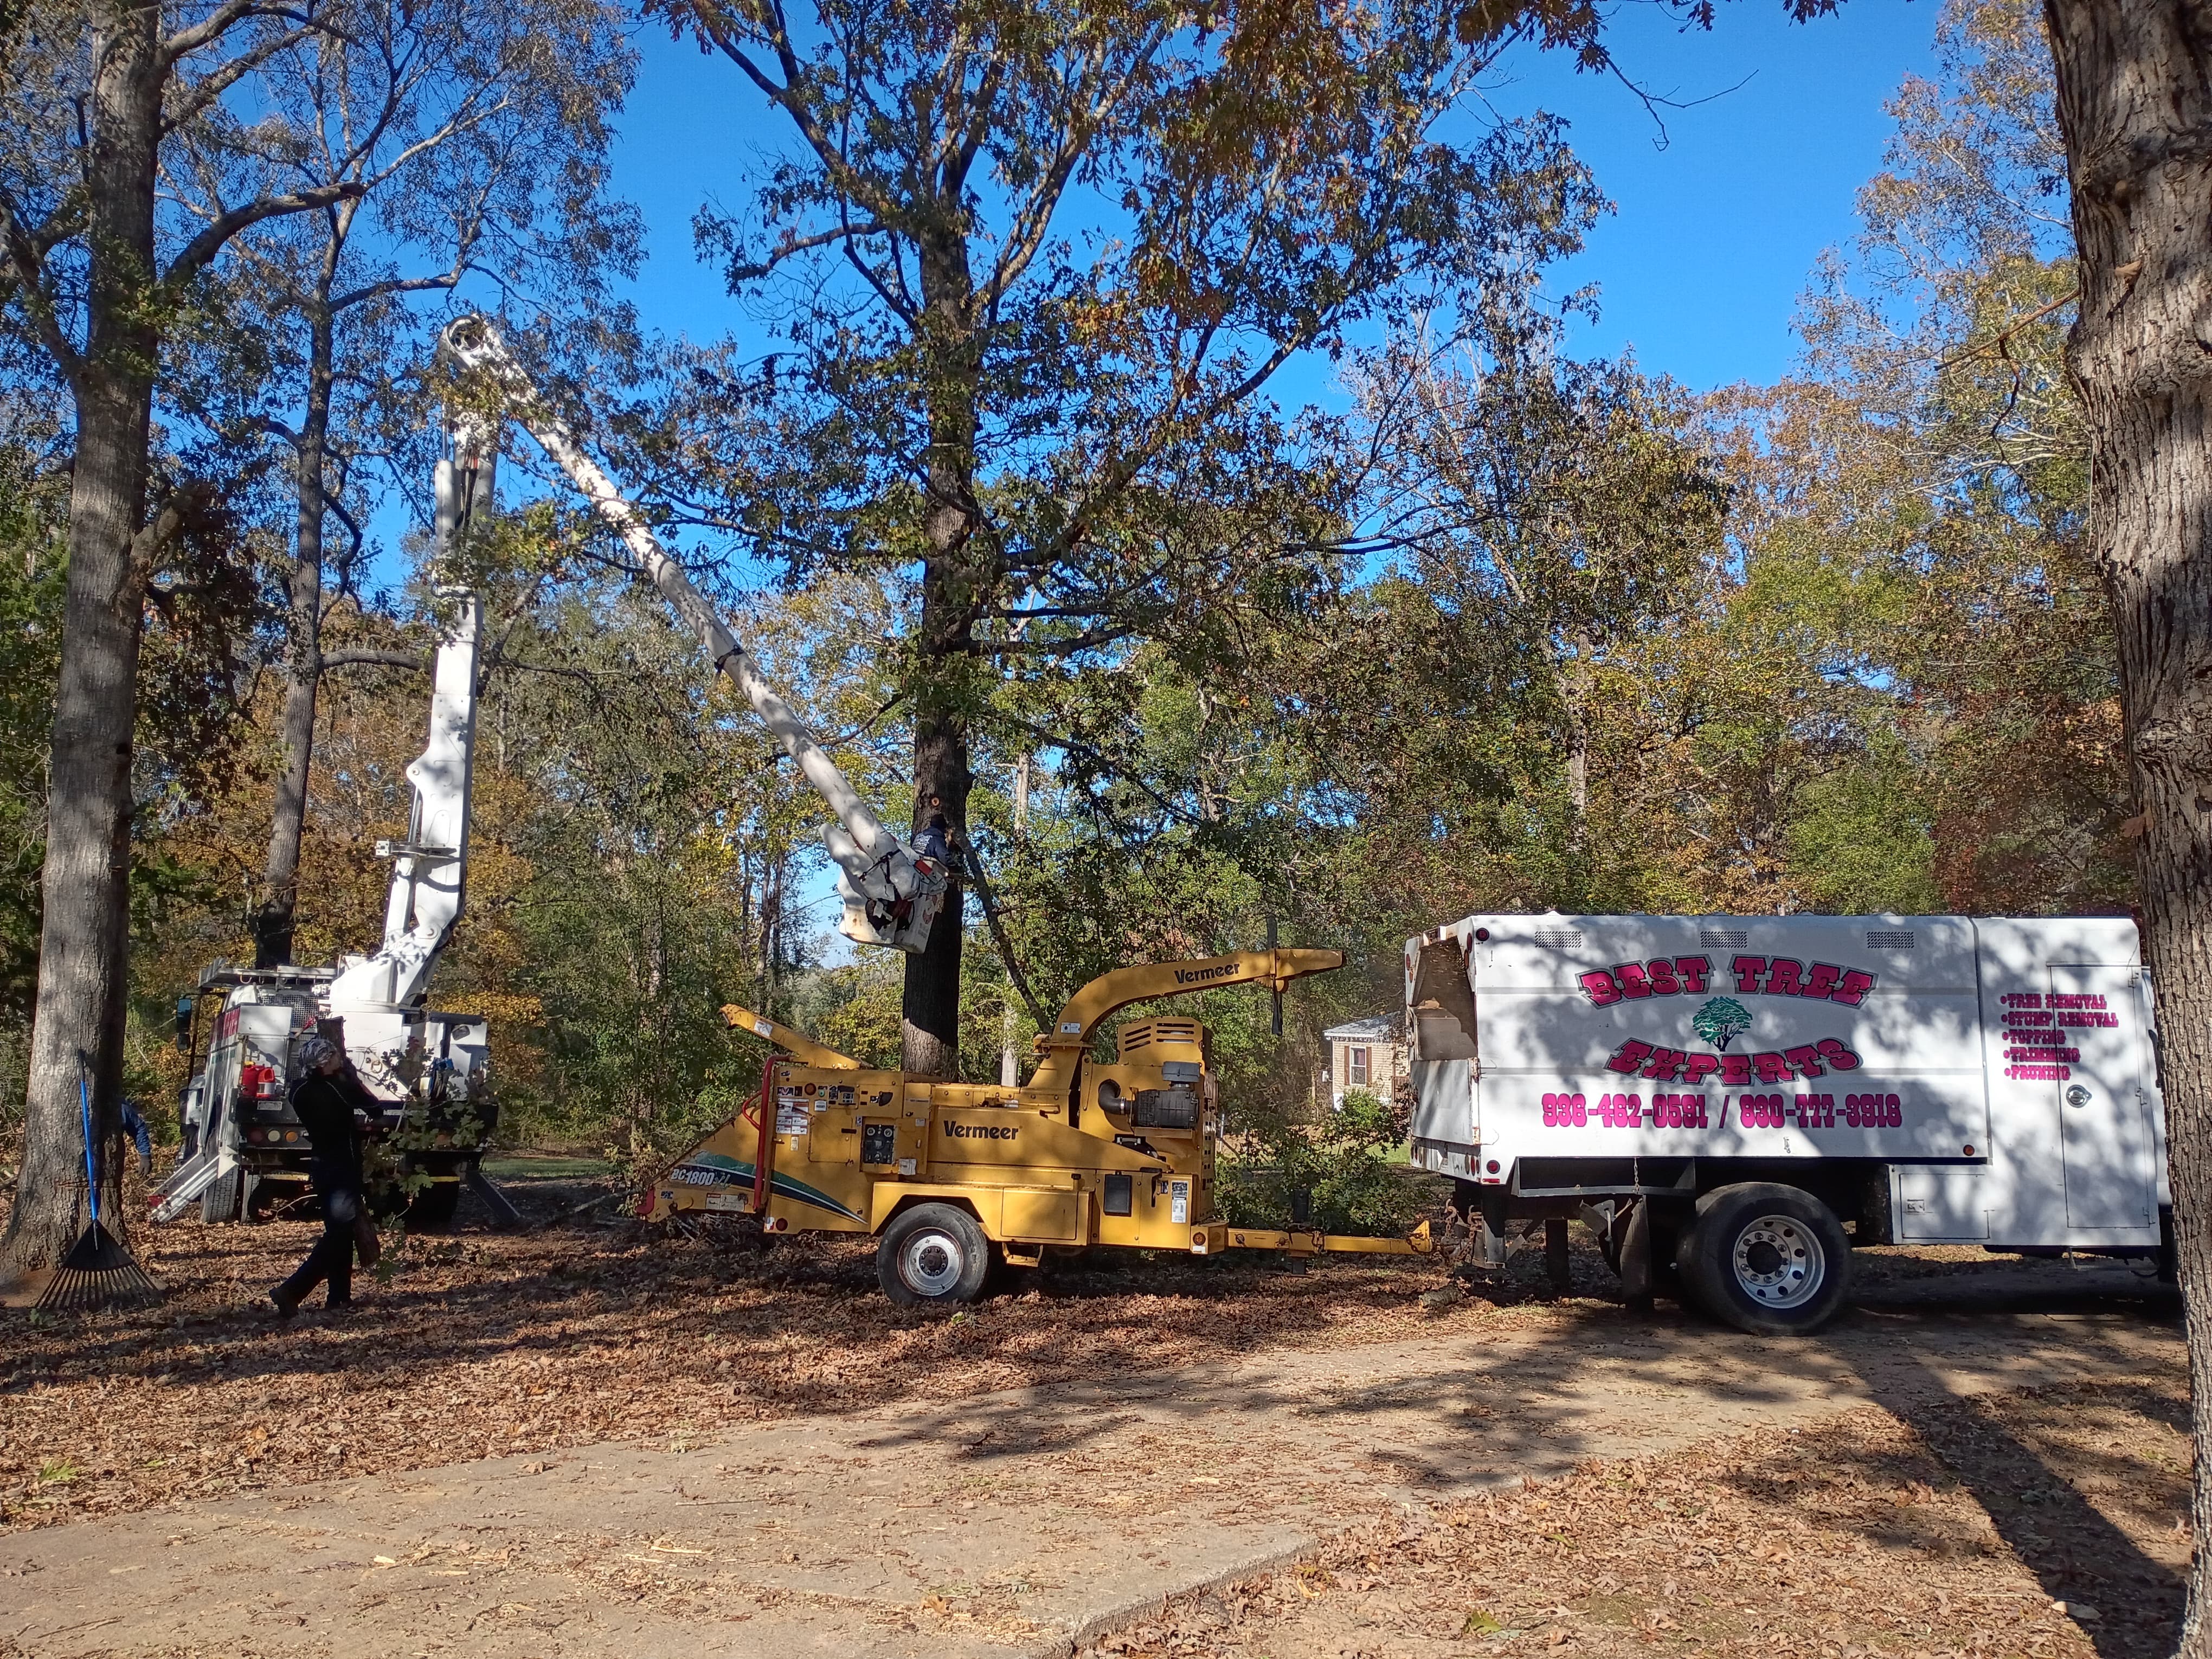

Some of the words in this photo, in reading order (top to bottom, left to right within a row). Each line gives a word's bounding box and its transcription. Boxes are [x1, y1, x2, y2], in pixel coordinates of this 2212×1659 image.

[1174, 963, 1240, 984] Vermeer
[1578, 955, 1713, 1007] BEST
[1732, 955, 1875, 1007] TREE
[2007, 993, 2042, 1008] TREE
[2045, 994, 2107, 1009] REMOVAL
[2008, 1011, 2053, 1026] STUMP
[2057, 1012, 2119, 1027] REMOVAL
[2008, 1029, 2067, 1044] TOPPING
[1606, 1037, 1862, 1085] EXPERTS
[2009, 1046, 2081, 1063] TRIMMING
[2010, 1064, 2072, 1081] PRUNING
[1541, 1093, 1708, 1129] 936-462-0591
[1739, 1094, 1902, 1128] 830-777-3916
[943, 1120, 1019, 1140] Vermeer
[671, 1168, 715, 1186] BC1800
